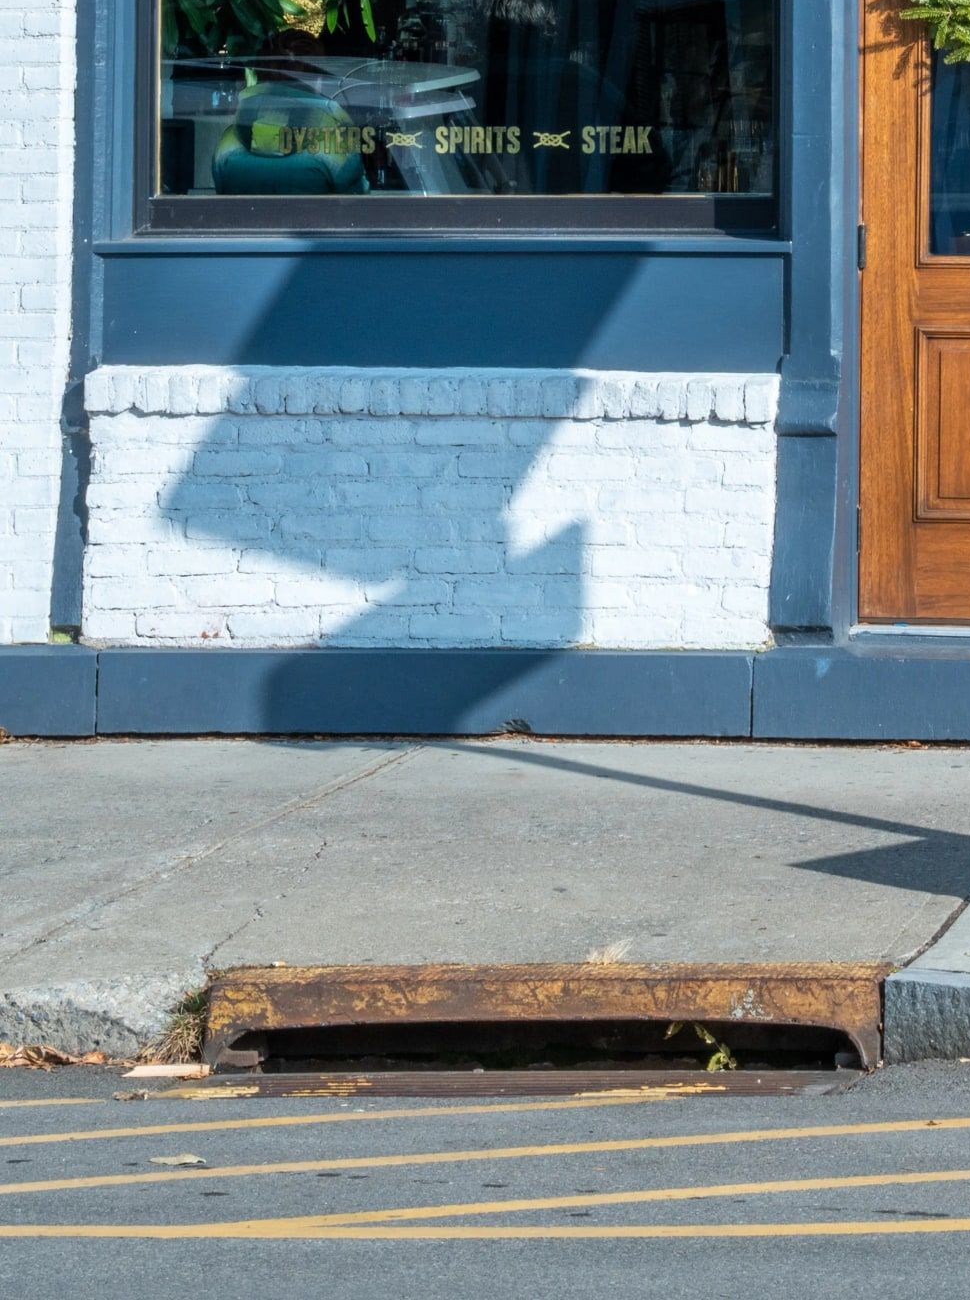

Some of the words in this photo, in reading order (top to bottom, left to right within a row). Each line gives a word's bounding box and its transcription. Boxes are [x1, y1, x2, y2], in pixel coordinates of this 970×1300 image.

[278, 126, 376, 154] OYSTERS
[435, 126, 521, 154] SPIRITS
[582, 126, 652, 154] STEAK
